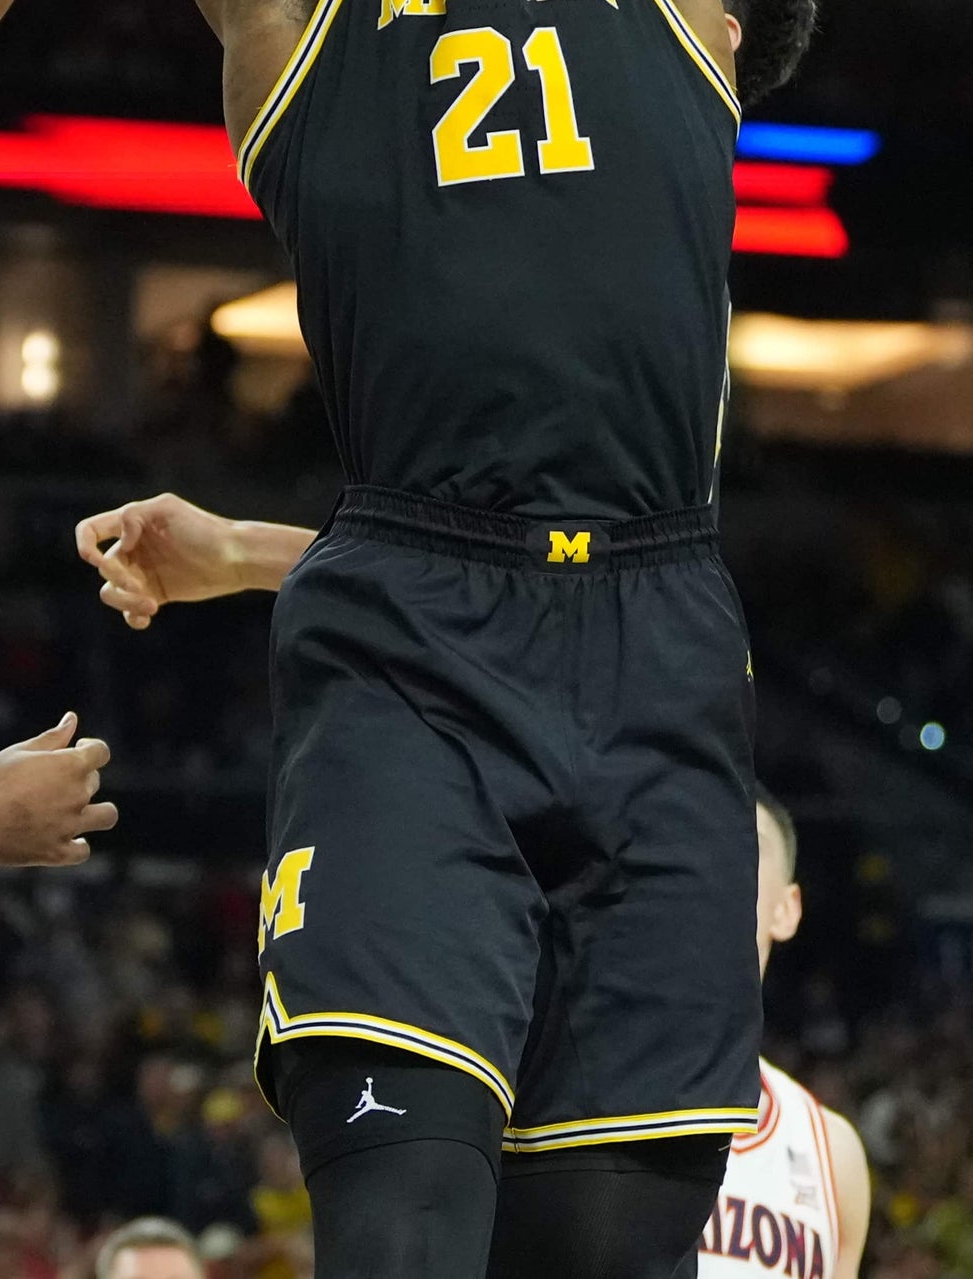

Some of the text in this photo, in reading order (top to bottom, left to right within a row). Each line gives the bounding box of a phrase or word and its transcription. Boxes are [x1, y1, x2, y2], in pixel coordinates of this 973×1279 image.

[429, 26, 595, 187] 21
[546, 530, 591, 563] M
[258, 845, 316, 958] M
[698, 1194, 824, 1279] IZONA
